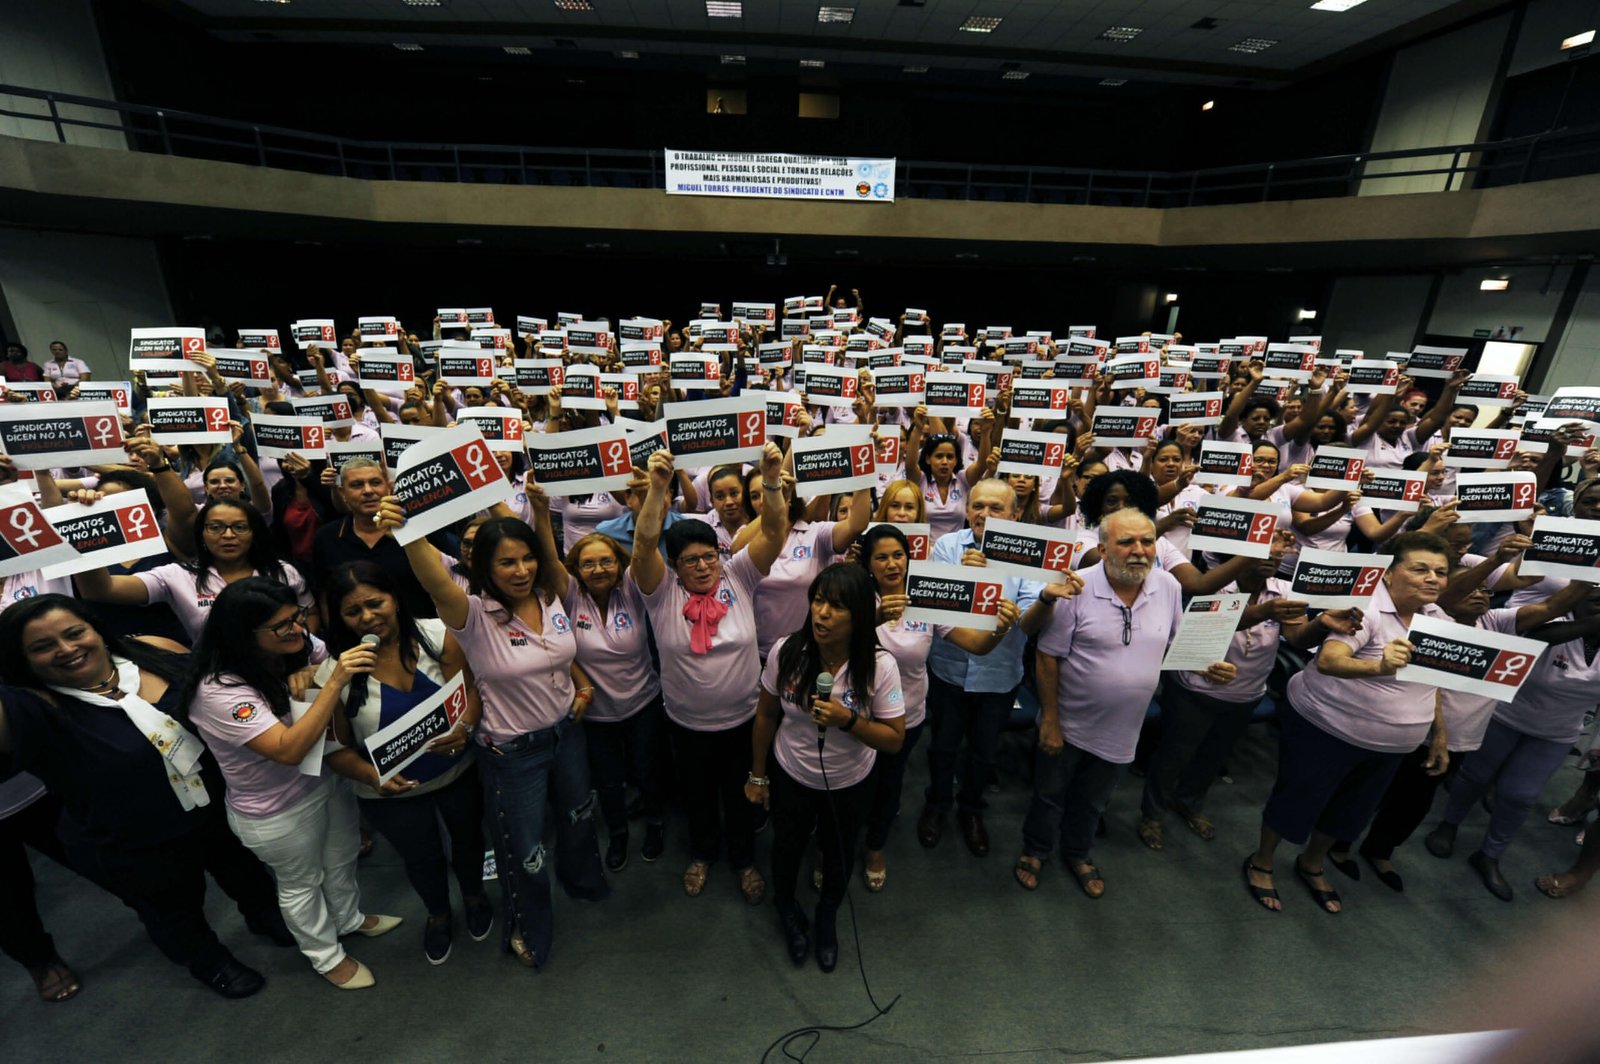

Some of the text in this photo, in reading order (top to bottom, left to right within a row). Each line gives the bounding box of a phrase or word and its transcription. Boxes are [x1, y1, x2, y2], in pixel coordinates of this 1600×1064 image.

[681, 153, 715, 161] TRABALHO
[756, 155, 782, 163] AGREGA
[721, 164, 750, 172] PESSOAL
[752, 165, 755, 173] E
[820, 168, 853, 177] RELAÇÕES
[703, 174, 720, 182] MAIS
[721, 175, 771, 183] HARMONIOSAS
[777, 177, 821, 185] PRODUTIVAS!
[733, 186, 771, 194] PRESIDENTE
[12, 422, 72, 432] SINDICATOS
[678, 419, 727, 431] SINDICATOS
[6, 433, 36, 442] DICEN
[58, 431, 66, 439] A
[69, 430, 83, 438] LA
[671, 427, 734, 442] DICEN NO A LA
[538, 450, 588, 461] SINDICATOS
[802, 451, 842, 462] SINDICATOS
[533, 457, 598, 470] DICEN NO A LA
[797, 463, 818, 471] DICEN
[839, 459, 849, 467] LA
[393, 462, 443, 494] NDICATOS
[414, 470, 459, 494] NO A LA
[1205, 511, 1245, 521] SINDICATOS
[1230, 521, 1237, 529] A
[73, 531, 89, 540] NO
[102, 524, 116, 534] LA
[986, 542, 1008, 551] DICEN
[993, 535, 1037, 548] SINDICATOS
[1543, 535, 1594, 546] SINDICATOS
[1585, 548, 1598, 556] LA
[1309, 567, 1352, 576] SINDICATOS
[1298, 574, 1322, 583] DICEN
[918, 580, 965, 592] SINDICATOS
[910, 588, 970, 602] DICEN NO A LA
[1421, 638, 1484, 657] SINDICATOS
[1442, 652, 1460, 661] NO
[1460, 656, 1469, 664] A
[1471, 658, 1487, 668] LA
[386, 714, 436, 753] SINDICATOS
[380, 743, 408, 765] DICEN
[410, 733, 424, 745] NO
[426, 727, 433, 735] A
[434, 717, 445, 729] LA
